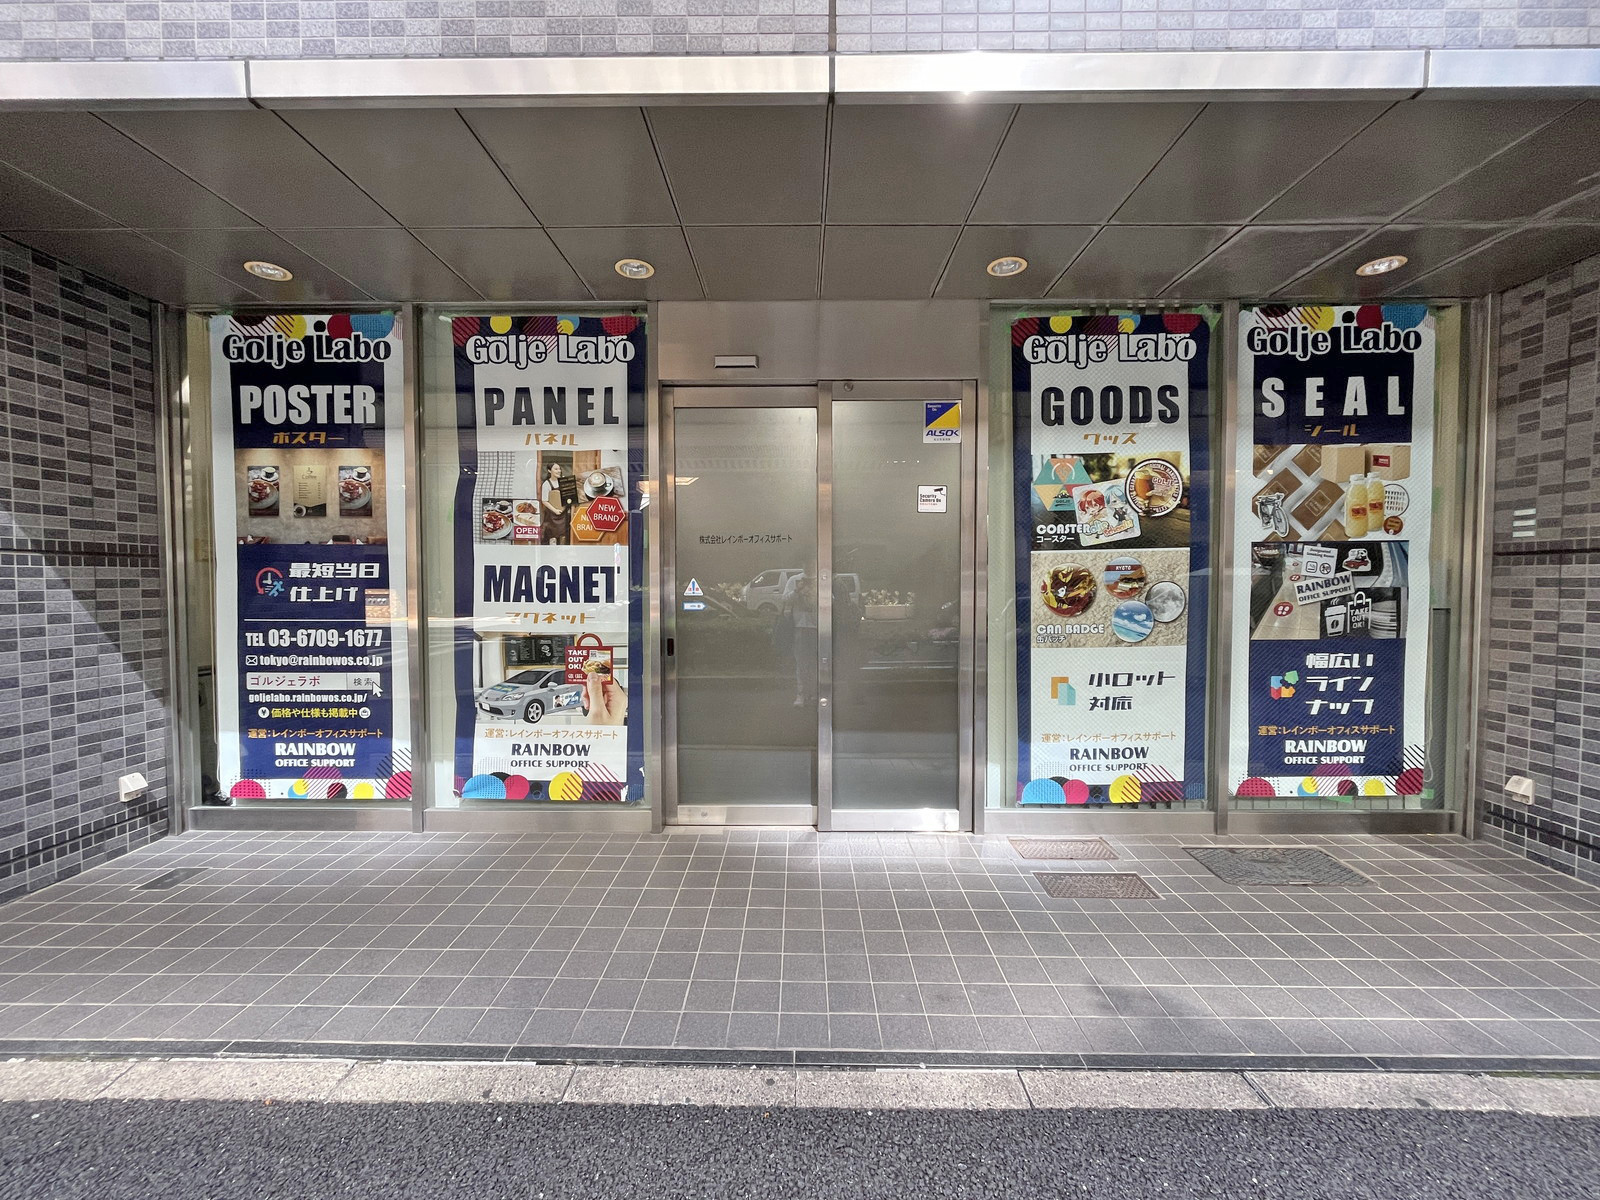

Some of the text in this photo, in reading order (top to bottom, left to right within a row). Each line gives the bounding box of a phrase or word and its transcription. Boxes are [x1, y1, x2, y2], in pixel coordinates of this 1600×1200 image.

[1247, 321, 1422, 361] Golje Labo
[222, 330, 392, 369] Golje Labo
[466, 334, 635, 369] Golje Labo
[1023, 332, 1197, 369] Golje Labo
[1261, 376, 1405, 418] SEAL
[239, 384, 376, 425] POSTER
[484, 386, 619, 426] PANEL
[1040, 384, 1180, 426] GOODS
[926, 429, 959, 437] ALSOK
[1304, 423, 1360, 437] シール
[272, 431, 345, 444] ポスター
[525, 433, 578, 446] パネル
[598, 504, 616, 512] NEW
[593, 514, 619, 523] BRAND
[1036, 523, 1091, 535] COASTER
[699, 534, 793, 545] 株式会社レインボーオフィスサポート
[1036, 535, 1074, 543] コースター
[288, 562, 380, 579] 最短当日
[483, 564, 620, 604] MAGNET
[1296, 574, 1351, 594] RAINBOW
[289, 586, 358, 602] 仕上げ
[1299, 585, 1352, 602] OFFICE SUPPORT
[1350, 607, 1368, 616] TAKE
[1036, 624, 1105, 635] CAN BADGE
[1352, 621, 1365, 629] OK!
[245, 629, 383, 648] TEL 03-6709-1677
[259, 654, 383, 667] tokyo@rainbowos.co.jp
[1305, 652, 1374, 669] 幅広い
[250, 675, 321, 687] ゴルジェラボ
[353, 677, 373, 687] 検索
[1088, 671, 1176, 687] 小ロット
[1306, 676, 1374, 692] ライン
[1089, 695, 1134, 711] 対応
[1306, 699, 1374, 715] ナップ
[271, 708, 358, 718] 価格や仕様も掲載中
[275, 742, 356, 756] RAINBOW
[511, 743, 591, 757] RAINBOW
[1069, 746, 1150, 760] RAINBOW
[1284, 739, 1367, 753] RAINBOW
[275, 758, 355, 768] OFFICE SUPPORT
[510, 759, 590, 768] OFFICE SUPPORT
[1069, 762, 1148, 772] OFFICE SUPPORT
[1284, 756, 1366, 765] OFFICE SUPPORT
